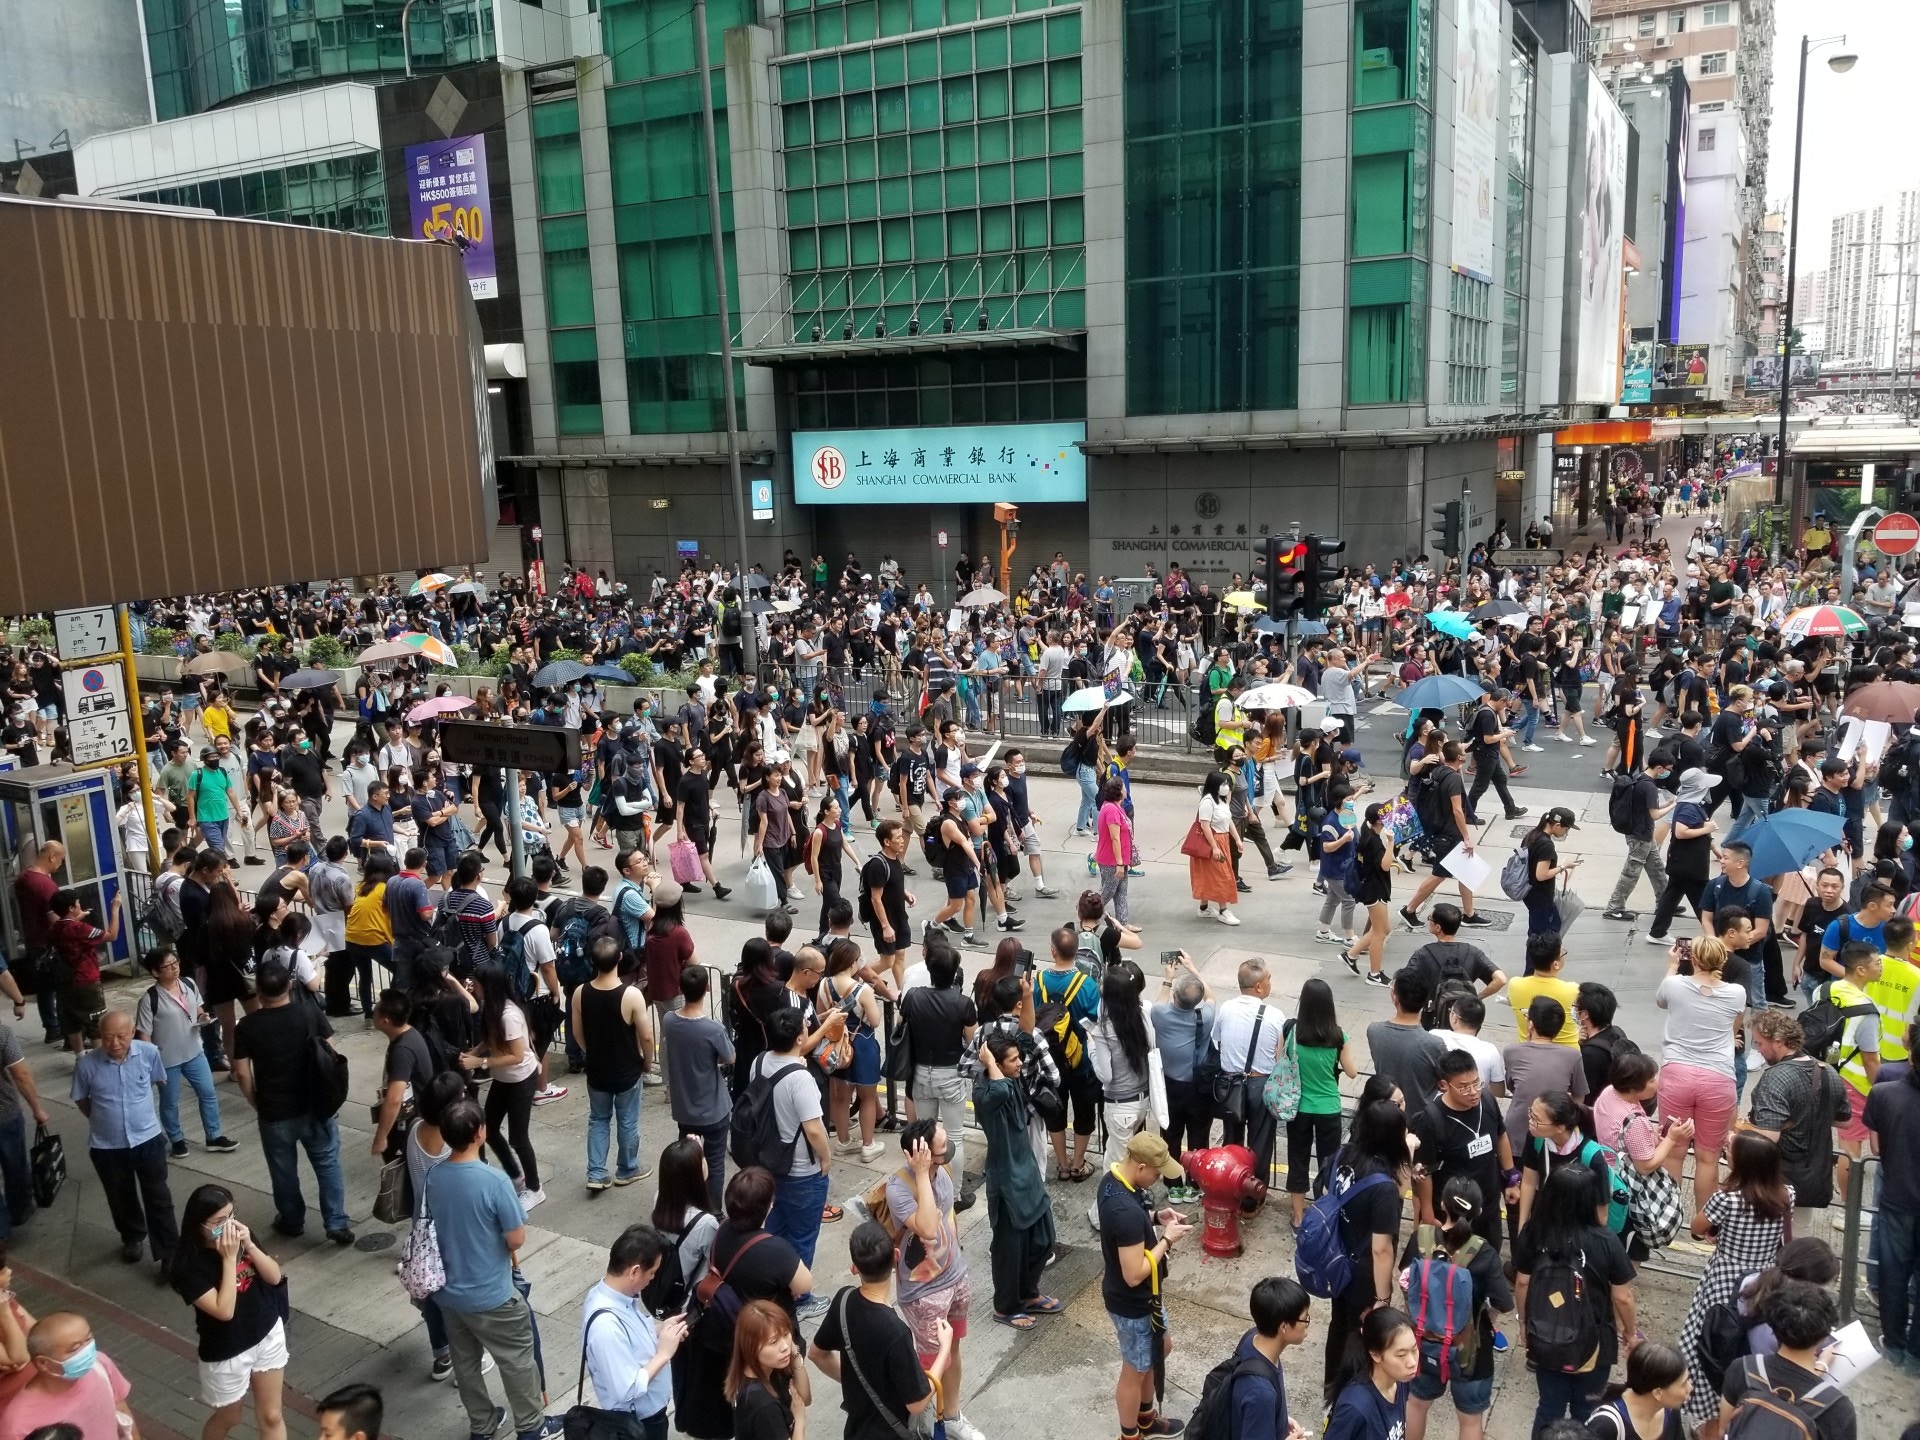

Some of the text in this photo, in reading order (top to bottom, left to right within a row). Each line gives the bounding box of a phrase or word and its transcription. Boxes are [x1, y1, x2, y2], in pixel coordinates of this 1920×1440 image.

[855, 446, 1016, 468] 上海商業銀行
[856, 472, 1018, 486] SHANGHAI COMMERCIAL BANK
[1149, 524, 1270, 536] 上海商業銀行
[1112, 541, 1249, 551] SHANGHAI COMMERCIAL
[69, 623, 85, 632] 上午
[93, 614, 104, 629] 7
[73, 637, 107, 651] pm 7
[71, 646, 88, 656] 下午
[82, 716, 117, 731] am 7
[81, 727, 98, 736] 上午
[506, 734, 529, 745] Road
[75, 738, 129, 754] midnight 12
[66, 812, 84, 820] PCCW
